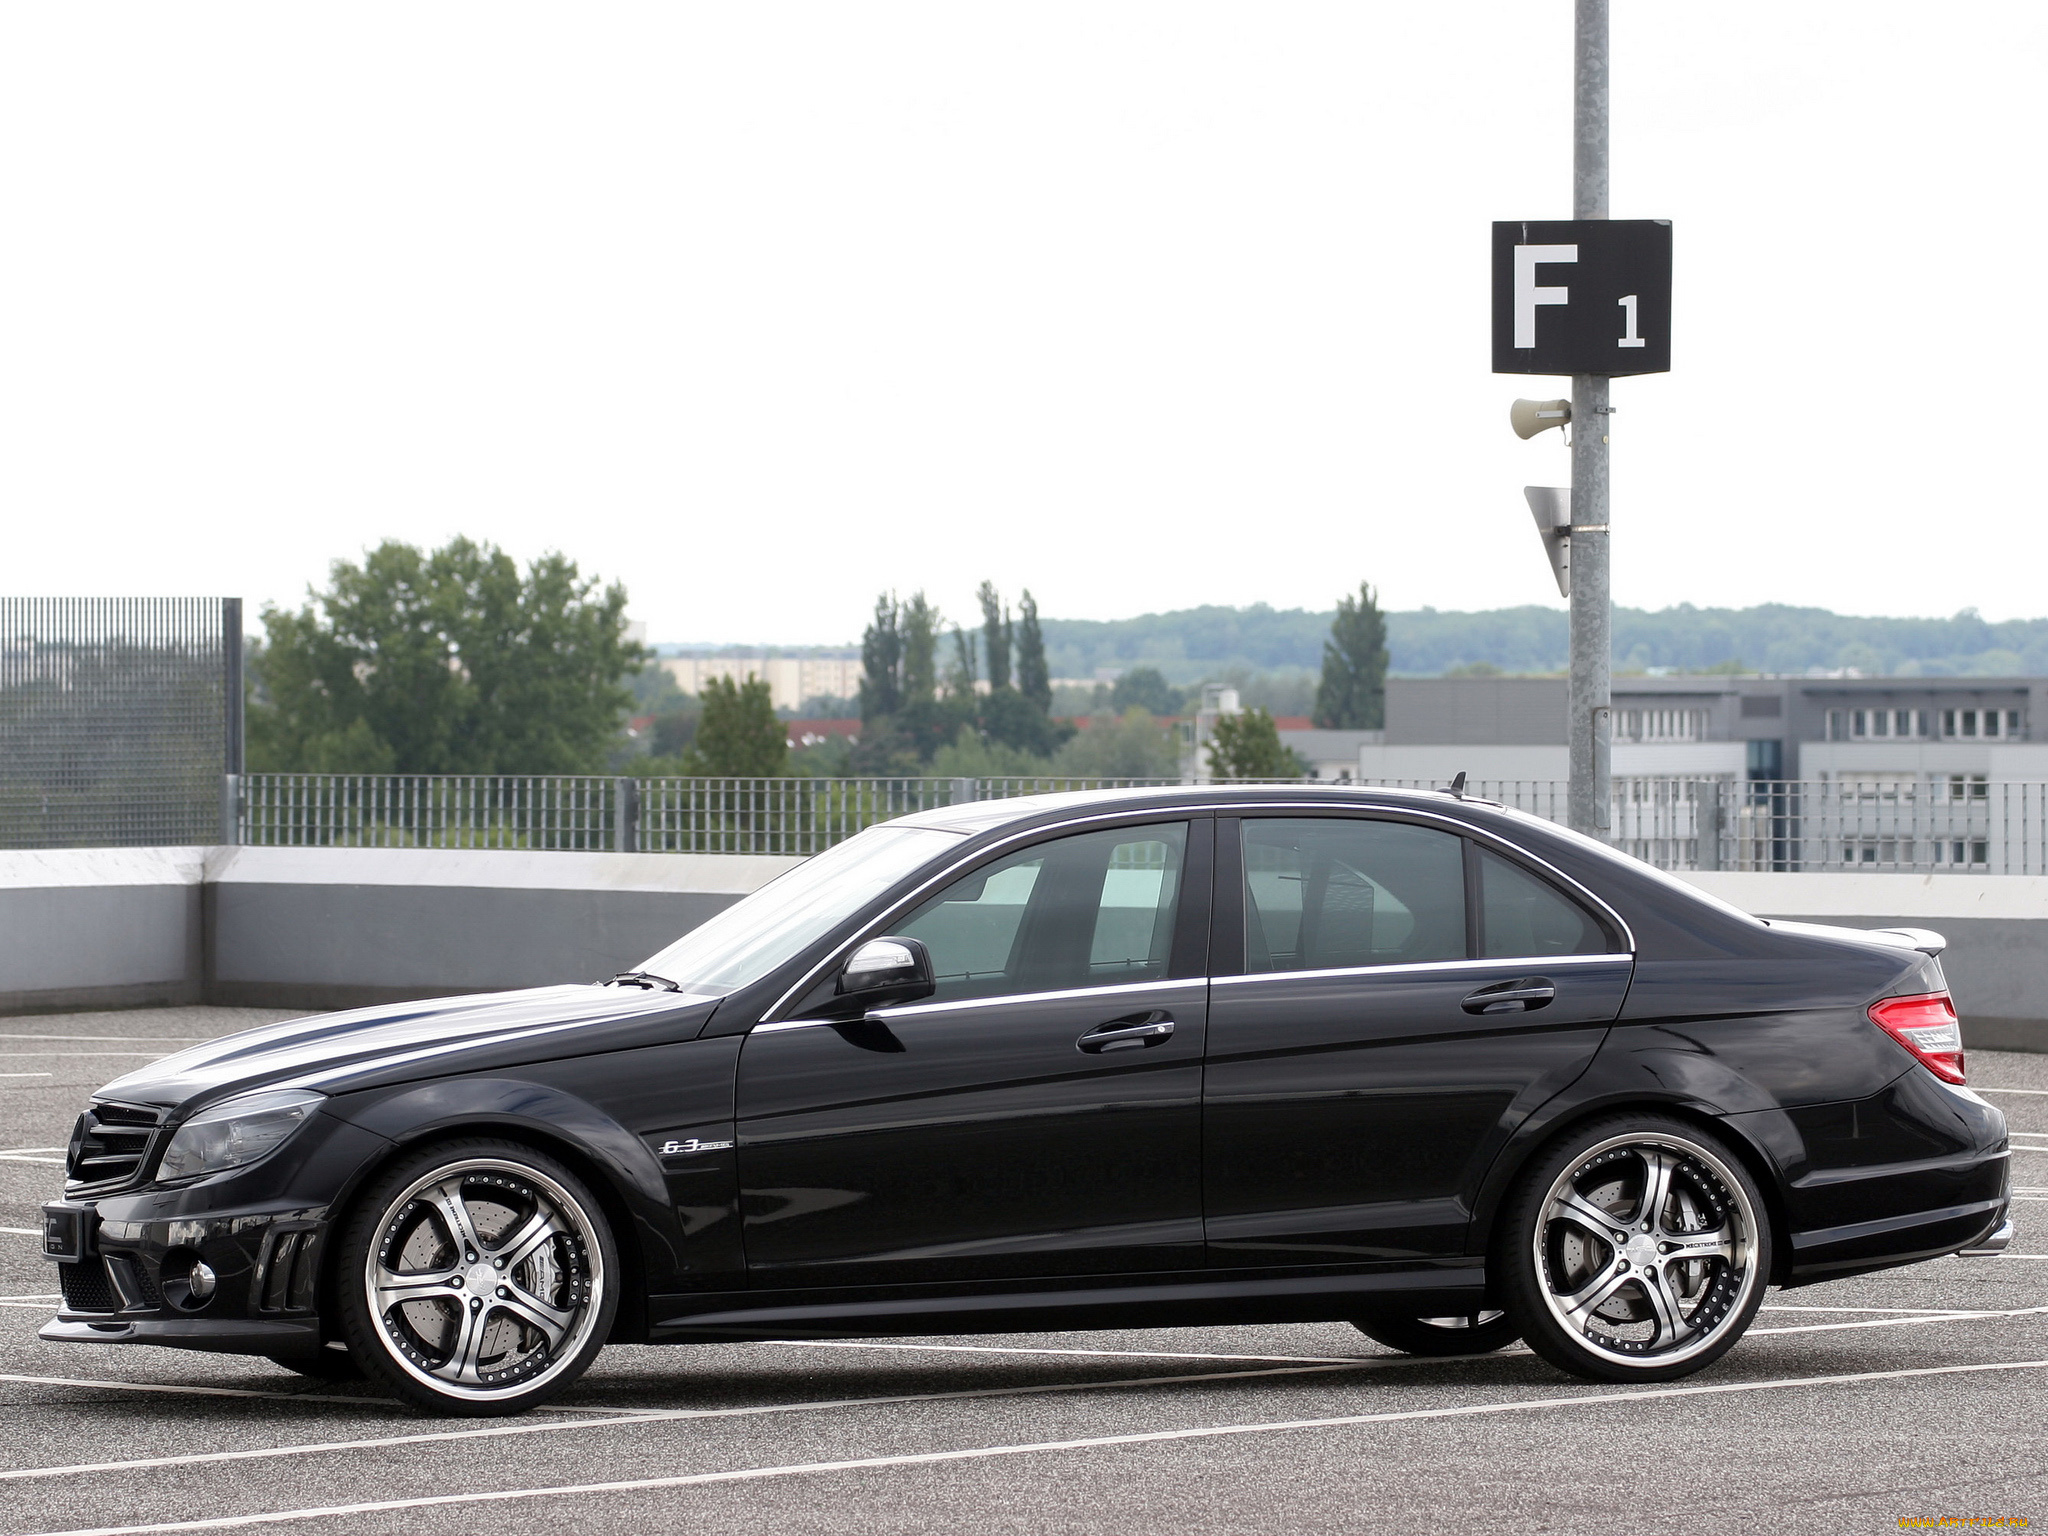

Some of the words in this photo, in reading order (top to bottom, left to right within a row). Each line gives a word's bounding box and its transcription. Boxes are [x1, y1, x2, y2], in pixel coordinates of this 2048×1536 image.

[1514, 244, 1578, 349] F
[1617, 295, 1646, 348] 1
[663, 1138, 699, 1154] 6.3
